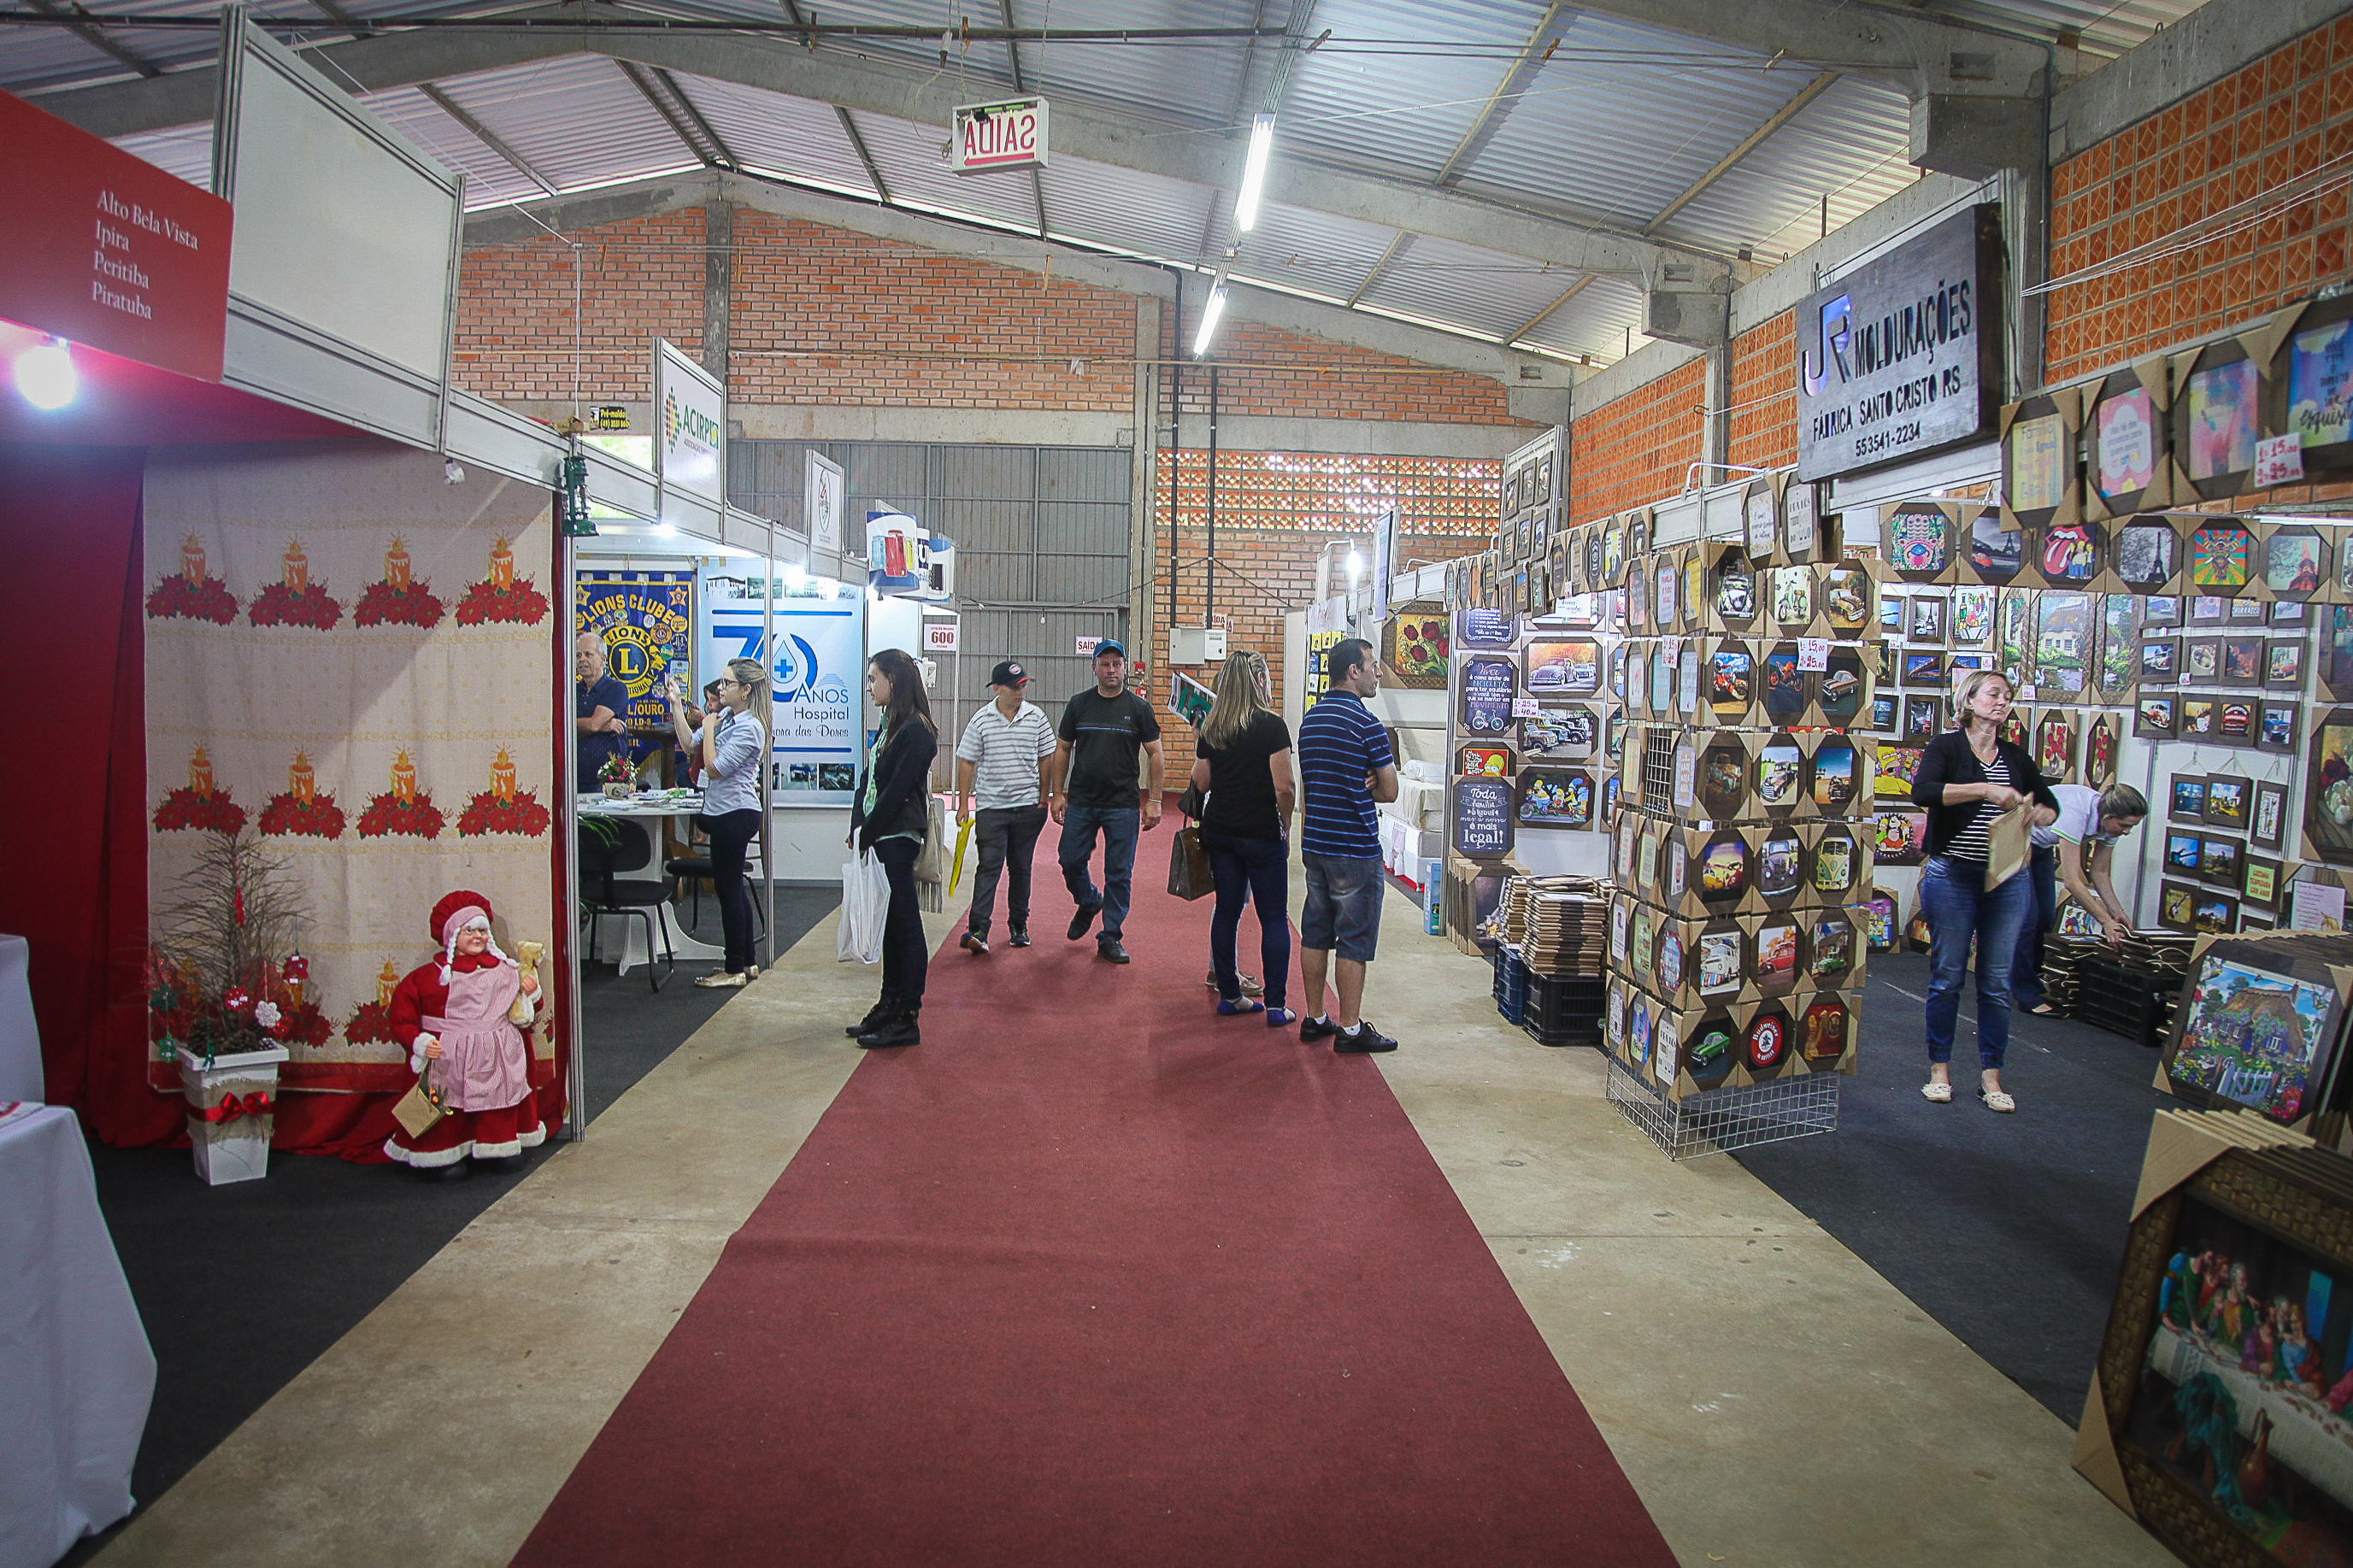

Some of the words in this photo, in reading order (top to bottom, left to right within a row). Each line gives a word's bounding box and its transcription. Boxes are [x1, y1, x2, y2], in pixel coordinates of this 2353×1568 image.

[97, 190, 129, 220] Alto
[132, 203, 161, 235] Bela
[163, 217, 199, 250] Vista
[95, 219, 130, 252] Ipira
[94, 250, 150, 290] Peritiba
[92, 281, 152, 320] Piratuba
[1855, 279, 1971, 379] MOLDURAÇÕES
[1813, 405, 1853, 443] FÁBRICA
[1860, 390, 1893, 426] SANTO
[1895, 373, 1938, 414] CRISTO
[1943, 365, 1961, 398] RS
[583, 594, 626, 623] LIONS
[628, 594, 676, 624] CLUBE
[607, 628, 650, 645] LIONS
[931, 631, 955, 644] 600
[1078, 638, 1099, 650] SAÍD
[618, 648, 639, 674] L
[1473, 679, 1507, 688] BICICLETA
[794, 683, 849, 704] ANOS
[794, 707, 849, 723] Hospital
[795, 725, 812, 737] das
[816, 725, 849, 737] Dores
[1470, 788, 1497, 800] Toda
[1471, 800, 1496, 809] família
[1477, 822, 1497, 831] mais
[1464, 829, 1504, 848] legal!
[1752, 1022, 1779, 1041] Budweiser
